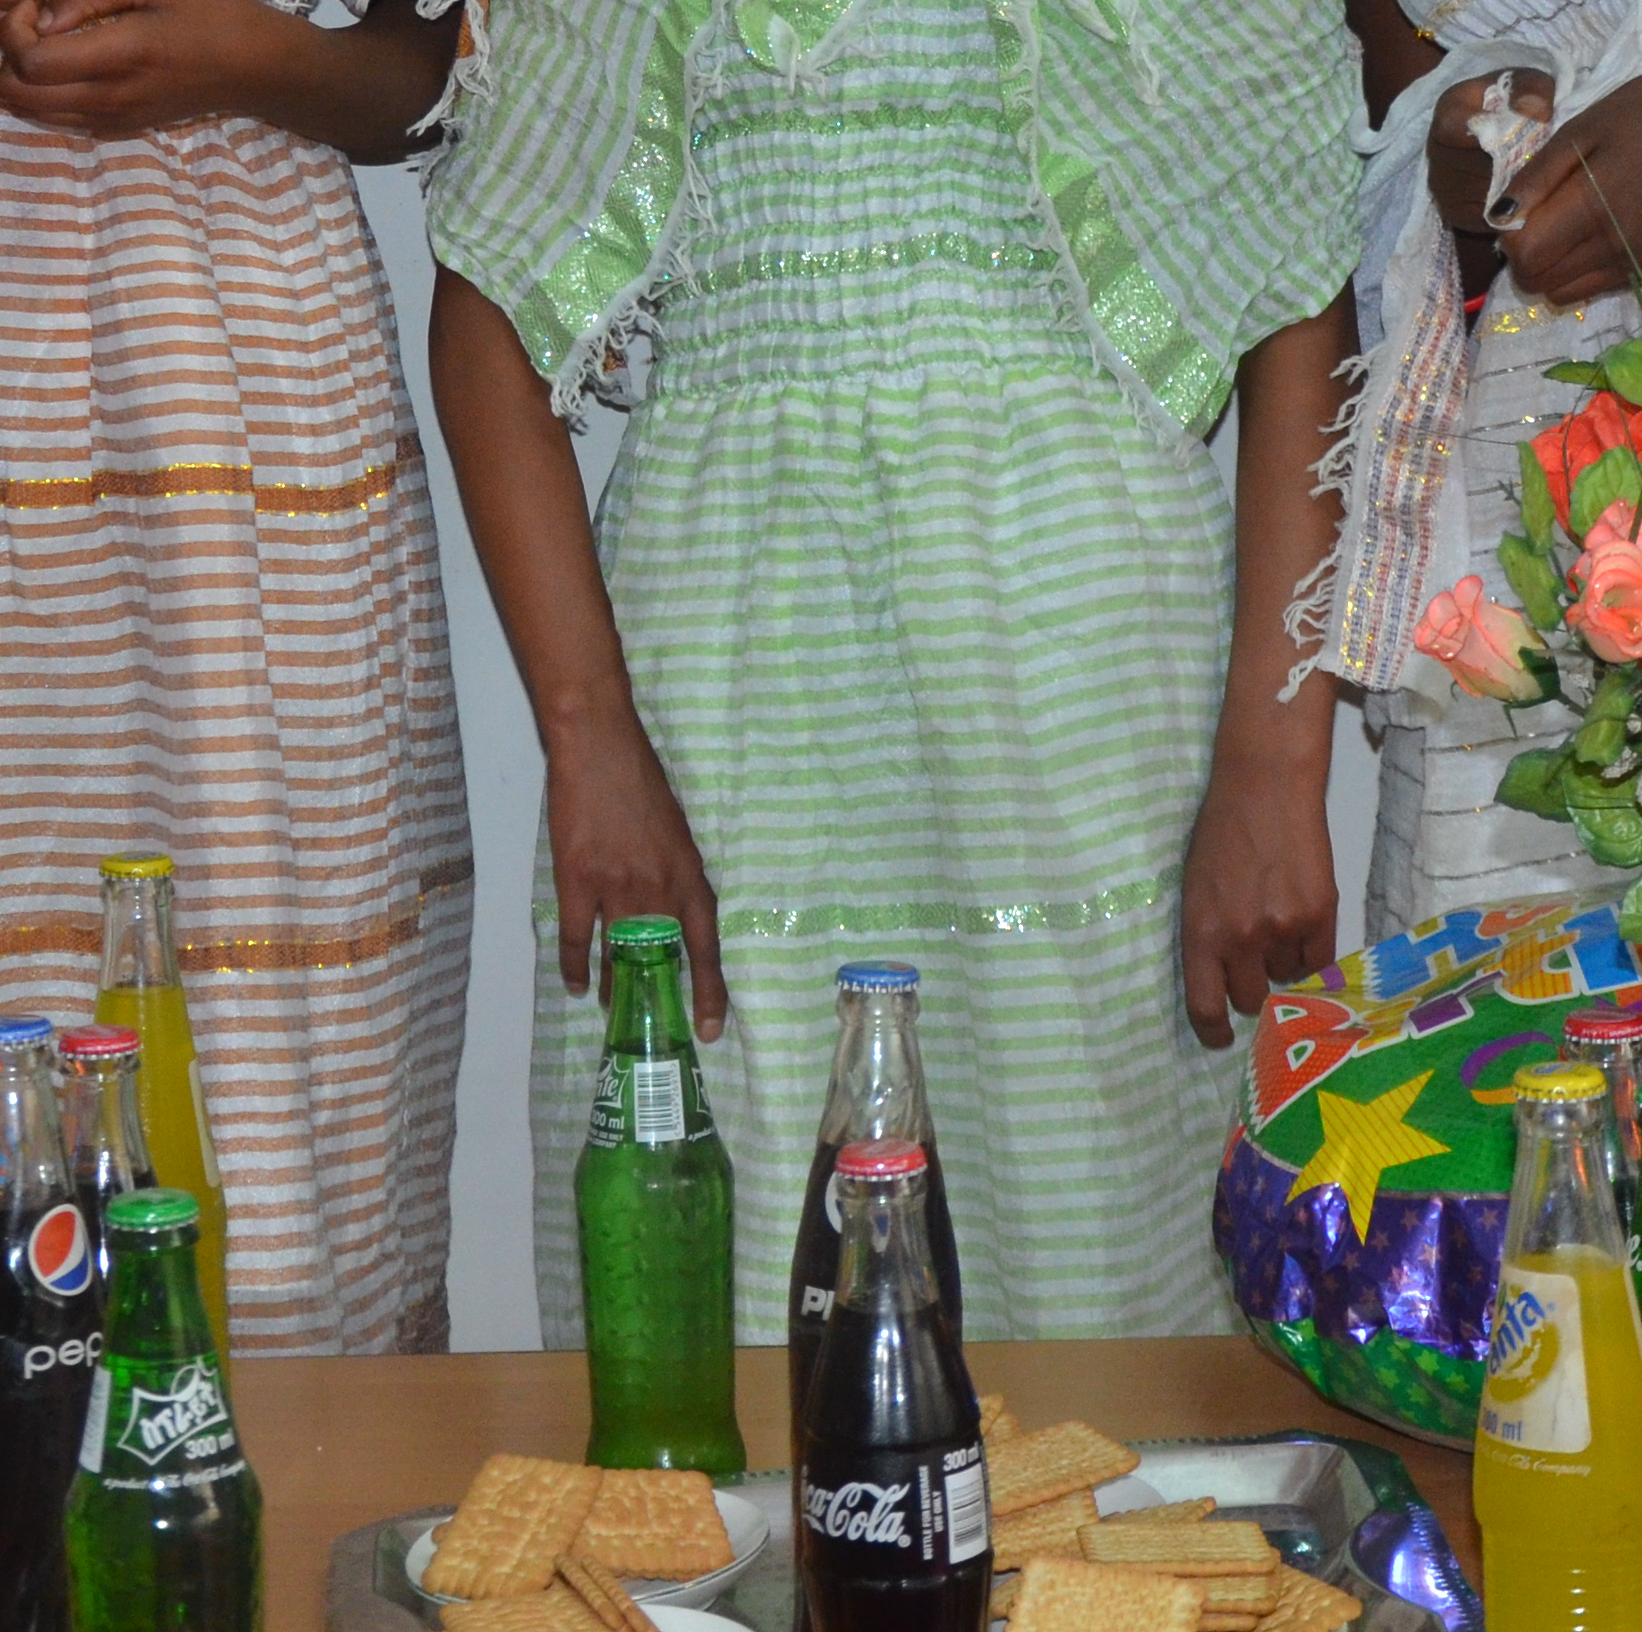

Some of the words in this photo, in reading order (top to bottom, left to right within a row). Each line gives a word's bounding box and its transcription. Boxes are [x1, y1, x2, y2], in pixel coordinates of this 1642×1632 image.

[608, 1115, 625, 1130] ml
[1489, 1291, 1546, 1376] anta
[24, 1331, 103, 1380] pep
[1502, 1420, 1523, 1441] ml
[184, 1435, 217, 1460] 300
[943, 1448, 967, 1471] 300
